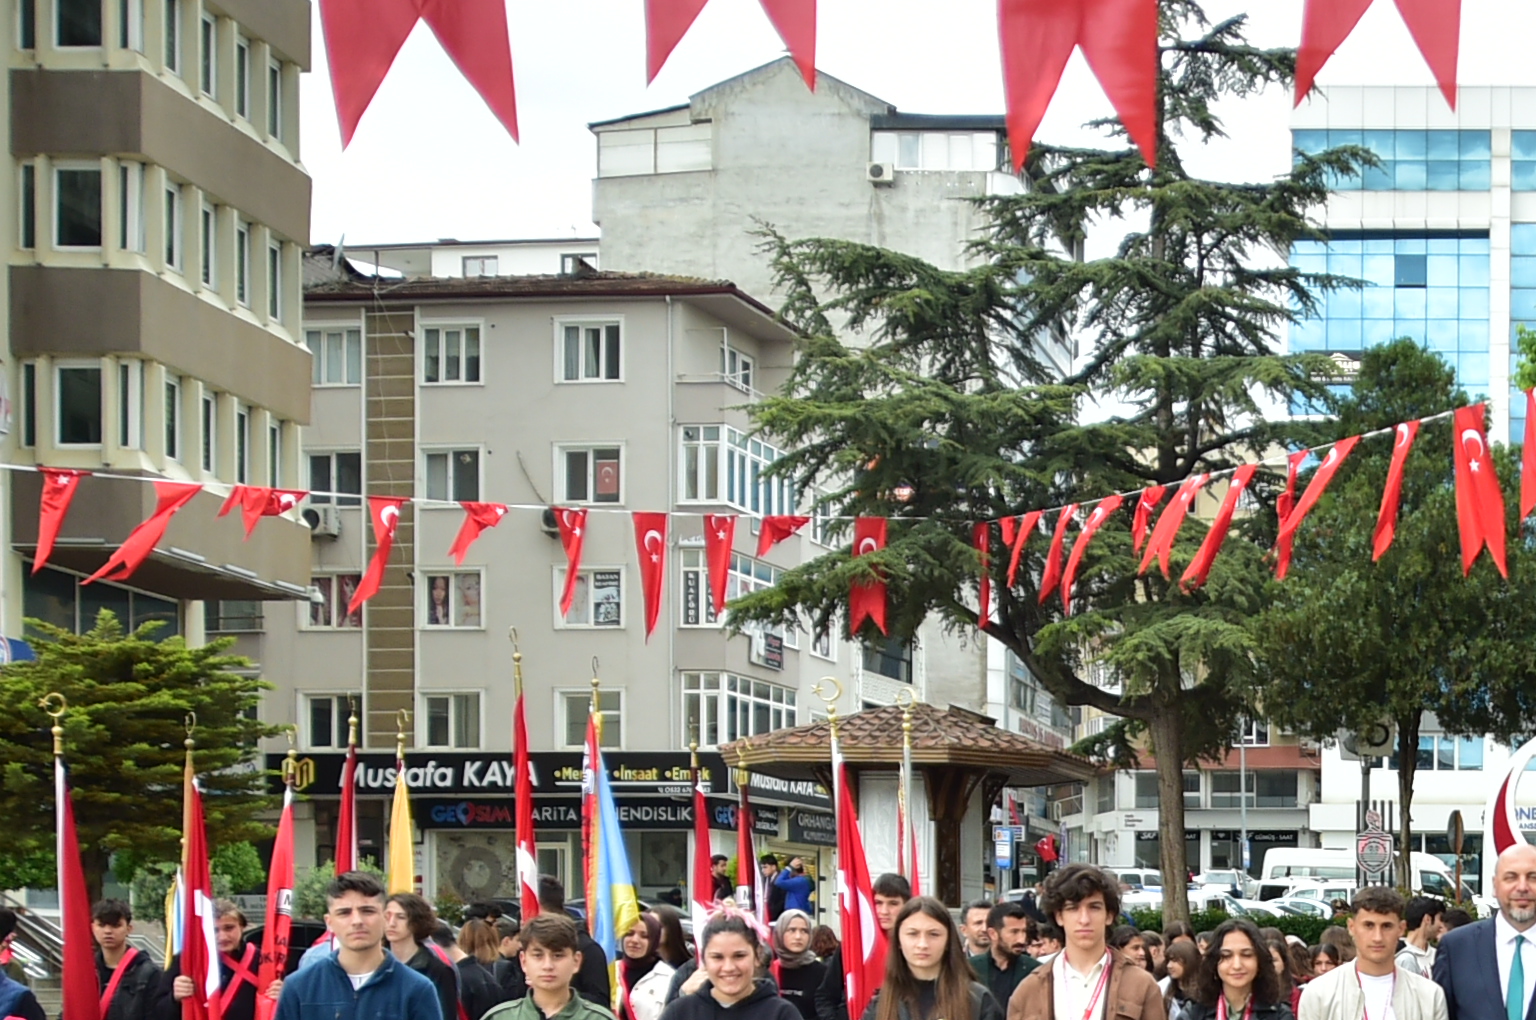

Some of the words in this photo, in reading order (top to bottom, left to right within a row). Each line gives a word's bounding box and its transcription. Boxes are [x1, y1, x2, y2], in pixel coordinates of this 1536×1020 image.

[338, 758, 453, 788] Musafa
[672, 766, 710, 781] Emk
[531, 805, 578, 821] ARİTA
[616, 805, 693, 821] ENDİSLİK
[798, 812, 837, 830] ORHANGA
